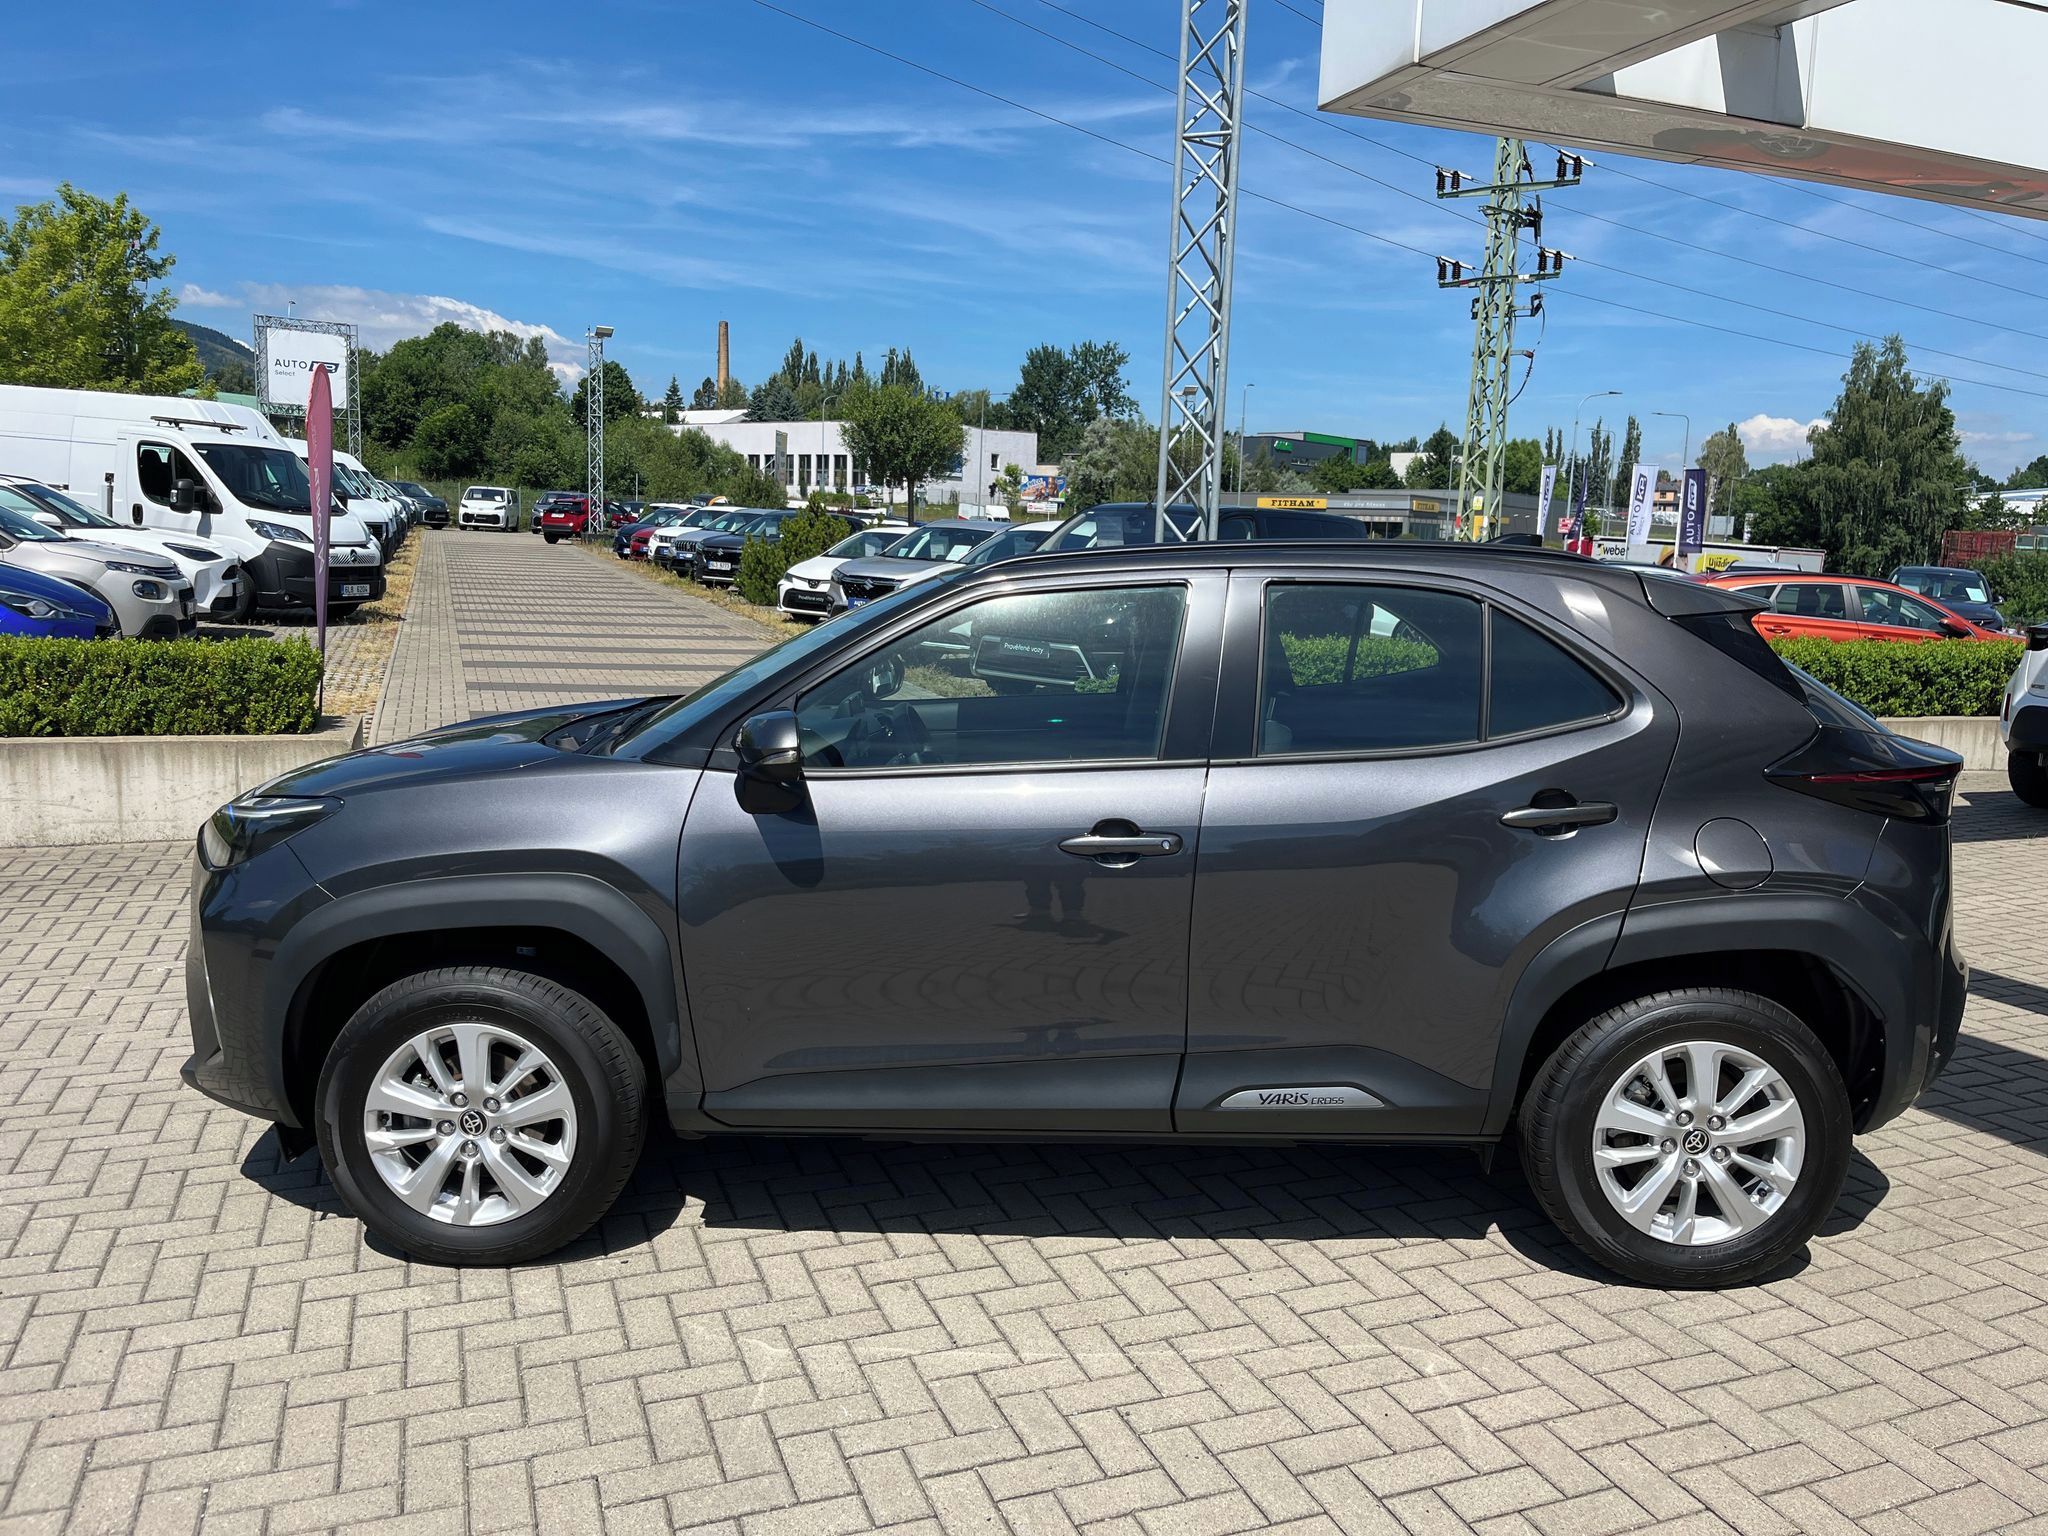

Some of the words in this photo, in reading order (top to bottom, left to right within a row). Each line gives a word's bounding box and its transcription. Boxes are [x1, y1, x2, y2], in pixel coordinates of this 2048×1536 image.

[275, 359, 307, 369] AUTO
[1271, 499, 1315, 507] FITHAM
[1629, 504, 1641, 535] AUTO
[1686, 511, 1696, 544] AUTO
[1031, 646, 1044, 654] vozy
